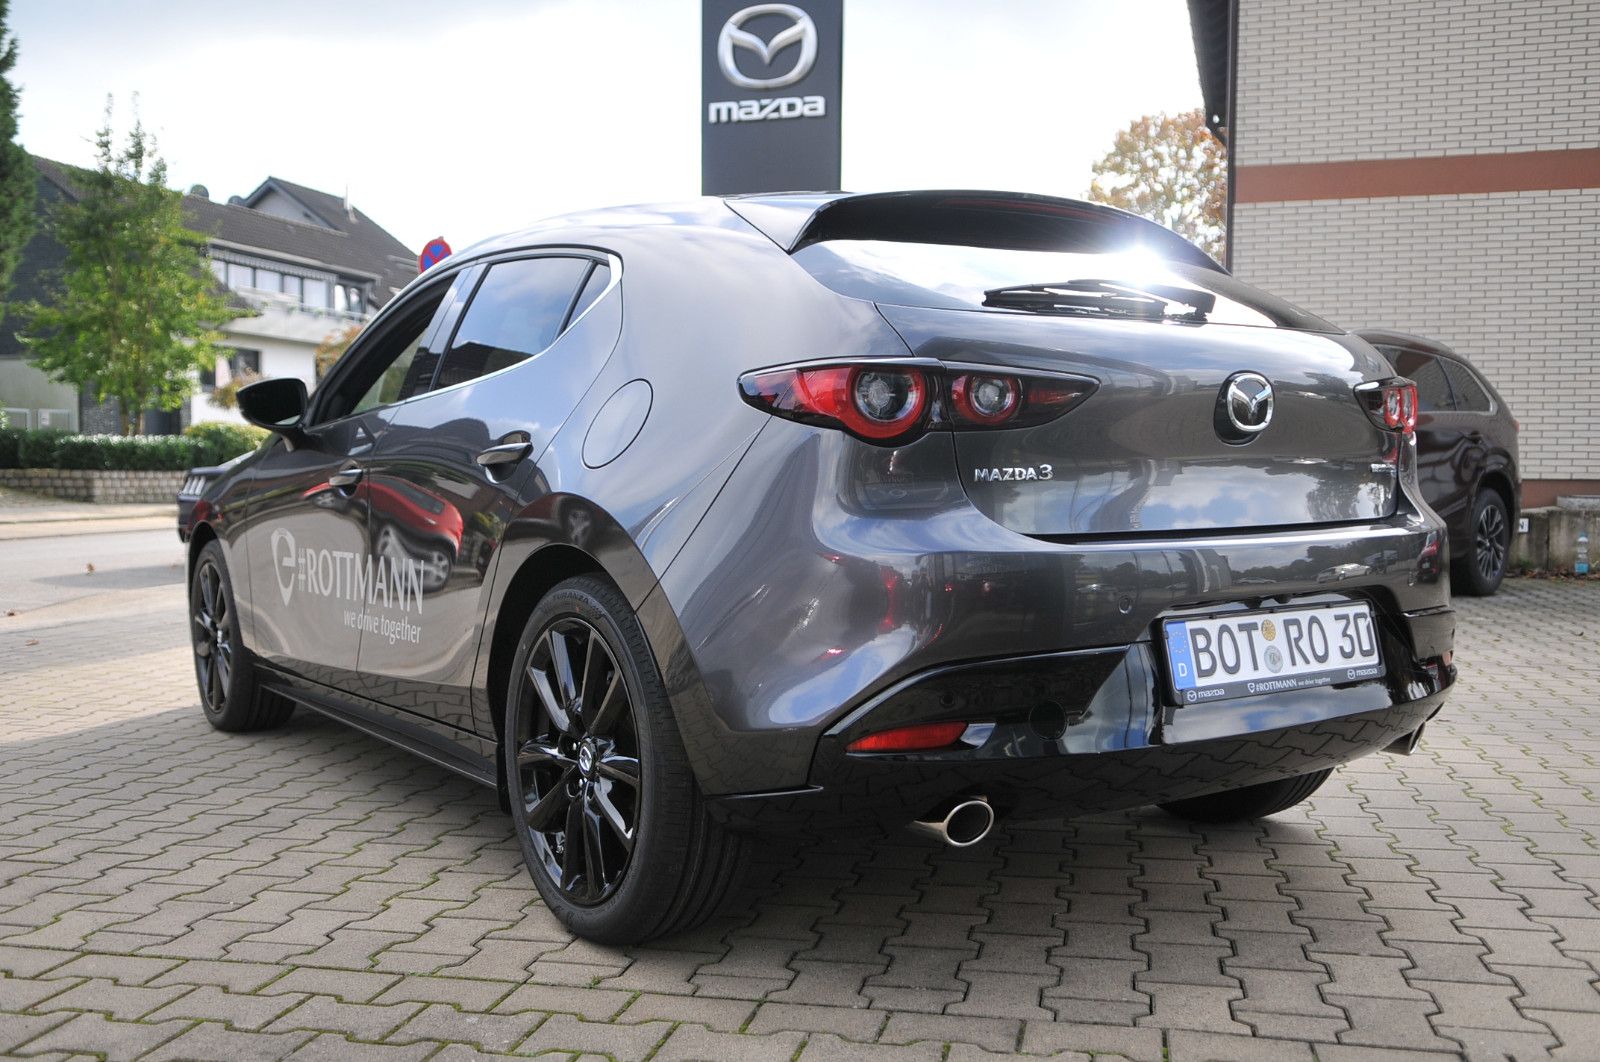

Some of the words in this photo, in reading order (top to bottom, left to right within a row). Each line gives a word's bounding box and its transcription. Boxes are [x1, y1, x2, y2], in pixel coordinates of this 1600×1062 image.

[974, 463, 1054, 482] MAZDA3
[343, 608, 356, 628] we
[357, 609, 379, 635] drive
[380, 615, 422, 645] together
[1189, 622, 1259, 678] BOT
[1283, 615, 1329, 667] RO
[1334, 612, 1376, 659] 30
[1177, 662, 1188, 677] D
